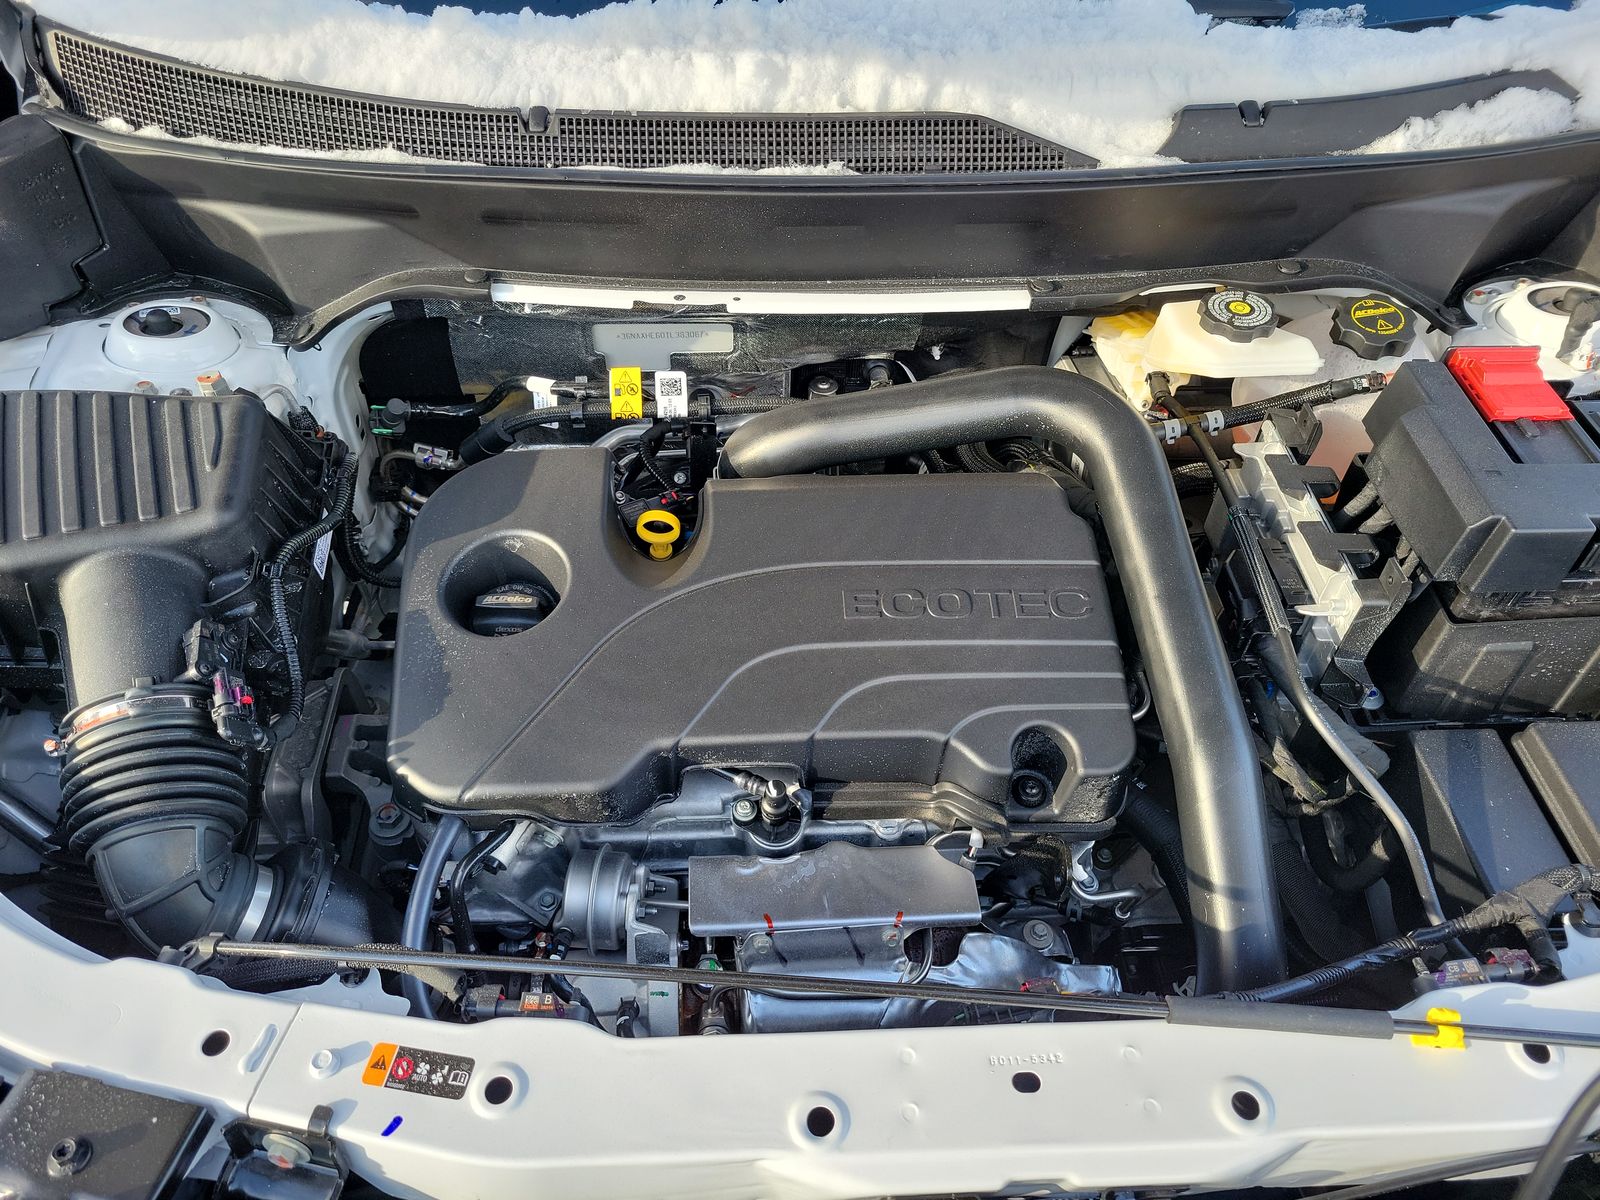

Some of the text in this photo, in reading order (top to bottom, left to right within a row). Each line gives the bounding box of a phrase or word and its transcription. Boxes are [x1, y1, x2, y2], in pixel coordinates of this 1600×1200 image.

[1354, 306, 1396, 318] ACDelco
[496, 585, 510, 594] SAE
[481, 595, 533, 604] ACDelco
[841, 588, 1094, 620] ECOTEC
[544, 994, 552, 1005] B
[411, 1074, 428, 1083] AUTO
